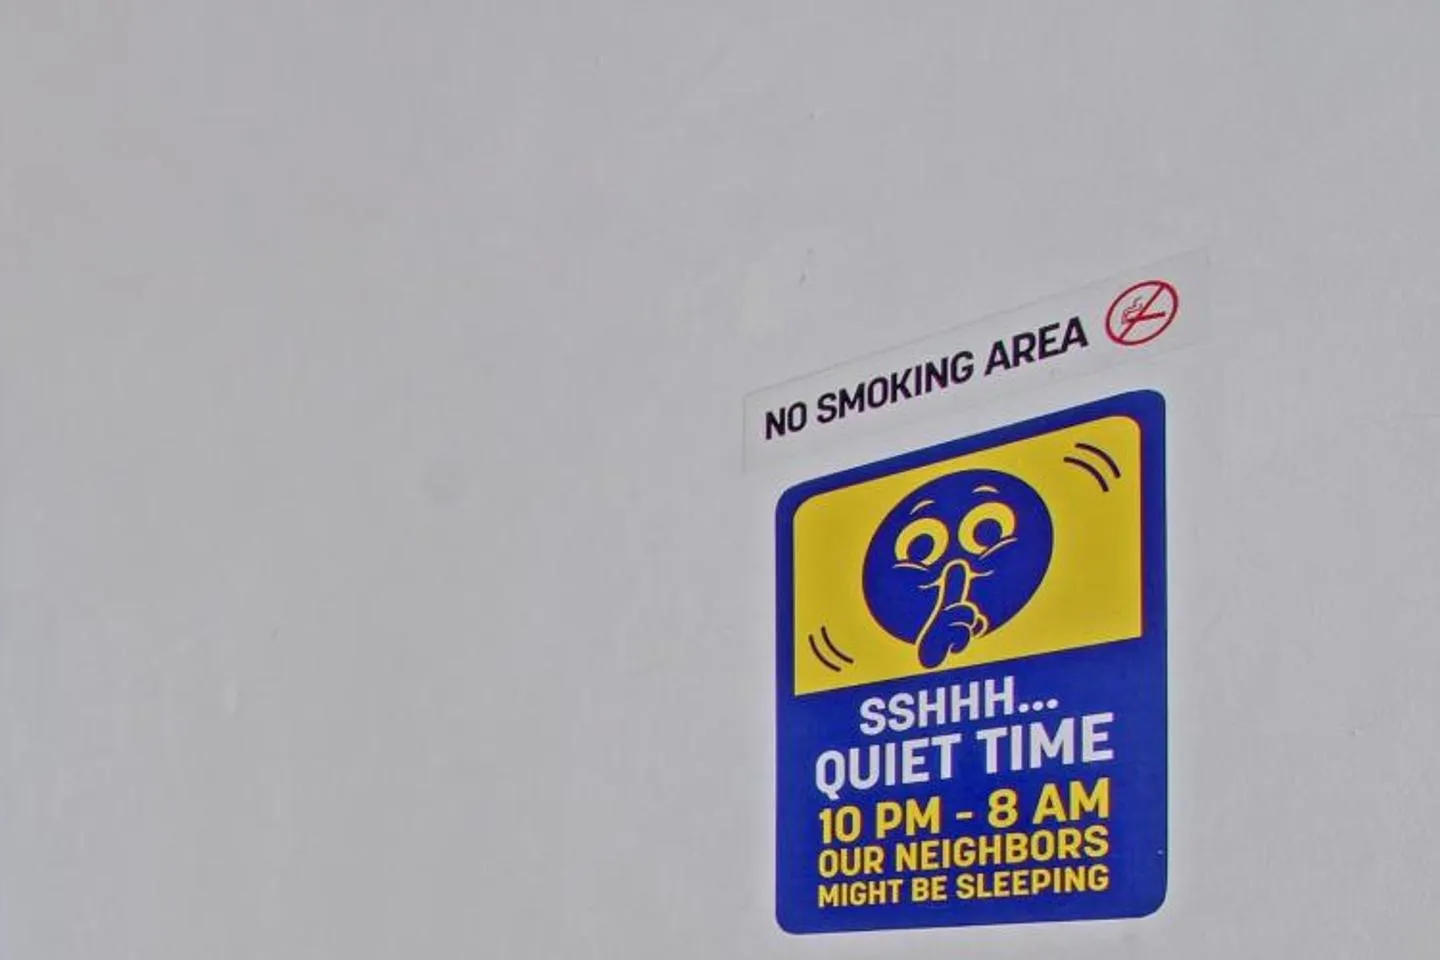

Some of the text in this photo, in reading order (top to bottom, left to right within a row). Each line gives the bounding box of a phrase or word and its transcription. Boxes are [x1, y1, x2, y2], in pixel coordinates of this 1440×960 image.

[764, 316, 1089, 440] NO SMOKING AREA
[859, 675, 1059, 735] SSHHH...
[815, 712, 1114, 800] QUIET TIME
[818, 777, 1111, 844] 10 PM - 8 AM
[817, 825, 1109, 878] OUR NEIGHBORS
[817, 865, 1109, 908] MIGHT BE SLEEPING
